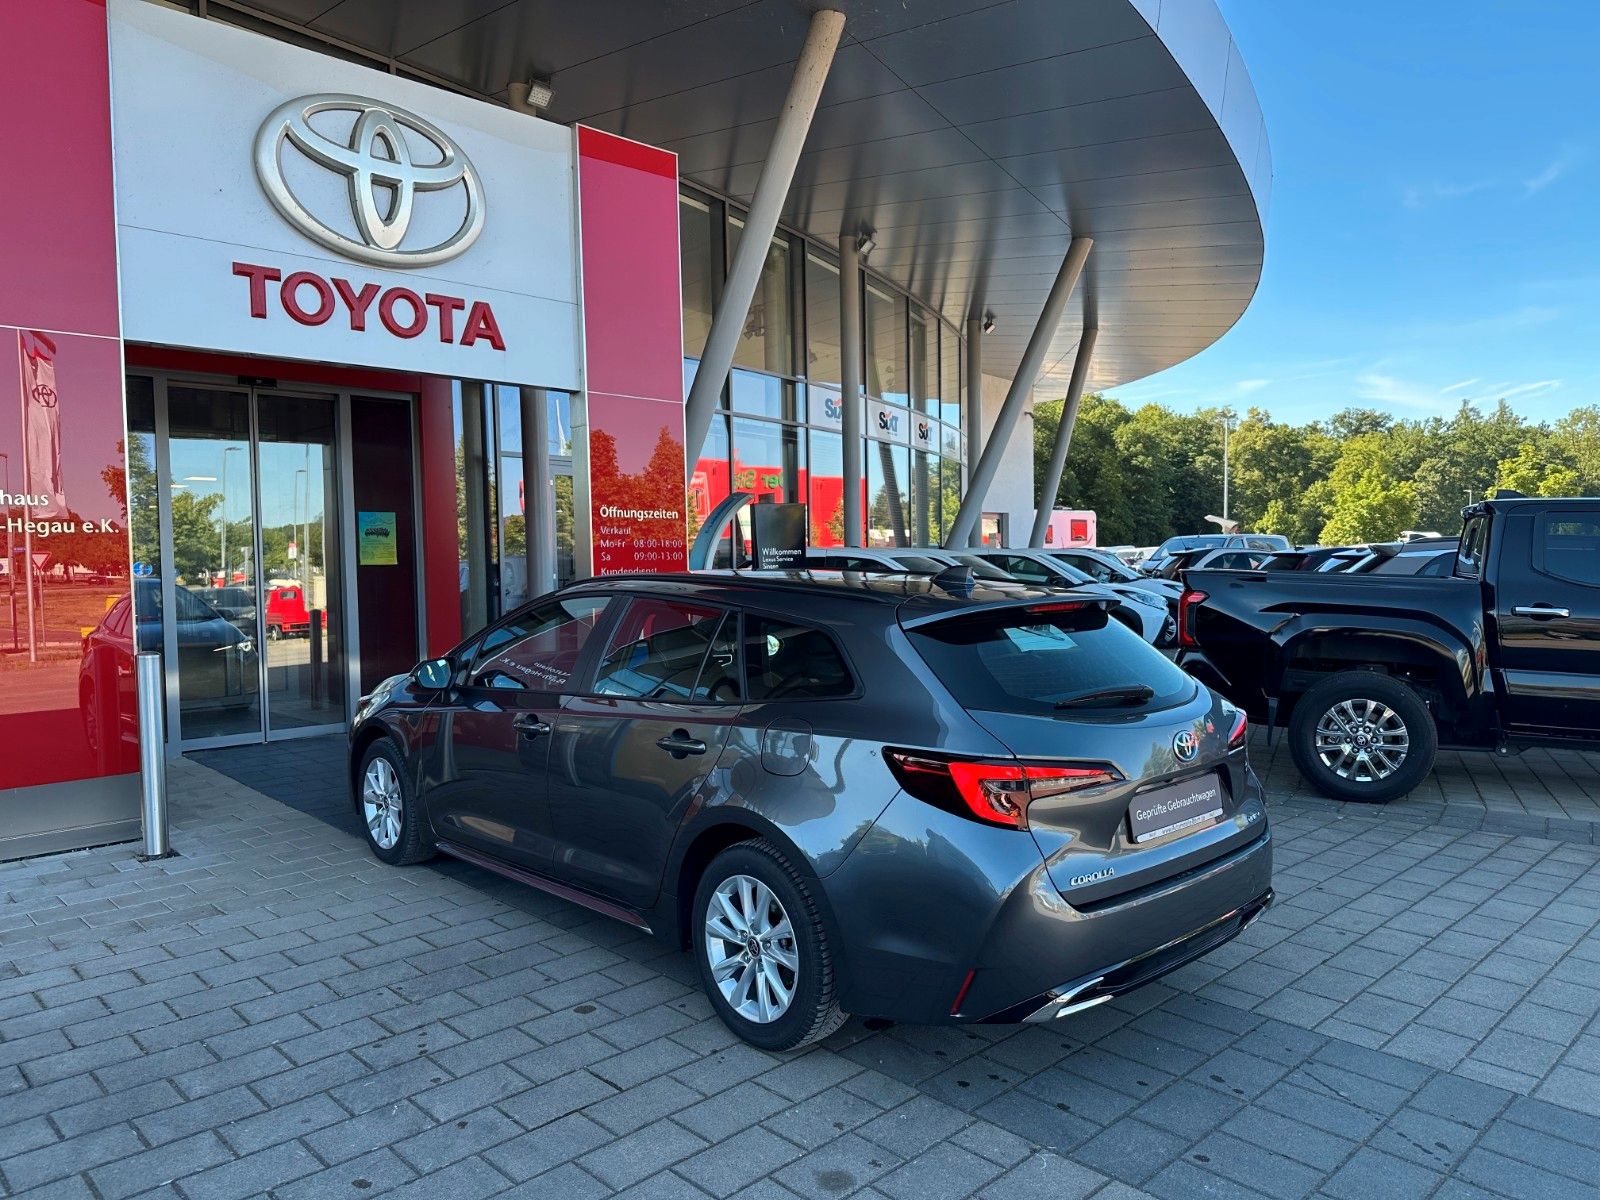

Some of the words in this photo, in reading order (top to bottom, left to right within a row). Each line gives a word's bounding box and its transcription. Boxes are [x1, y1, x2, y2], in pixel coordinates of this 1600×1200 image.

[232, 262, 506, 351] TOYOTA
[0, 490, 49, 506] haus
[600, 505, 679, 521] Öffnungszeiten
[82, 518, 120, 534] e.K.
[600, 525, 631, 535] Verkauf
[600, 539, 626, 548] Mo-Fr
[762, 547, 802, 556] Willkommen
[601, 551, 611, 561] Sa
[1136, 804, 1168, 822] Geprüfte
[1167, 788, 1217, 812] Gebrauchtwagen
[1070, 866, 1115, 886] COROLLA
